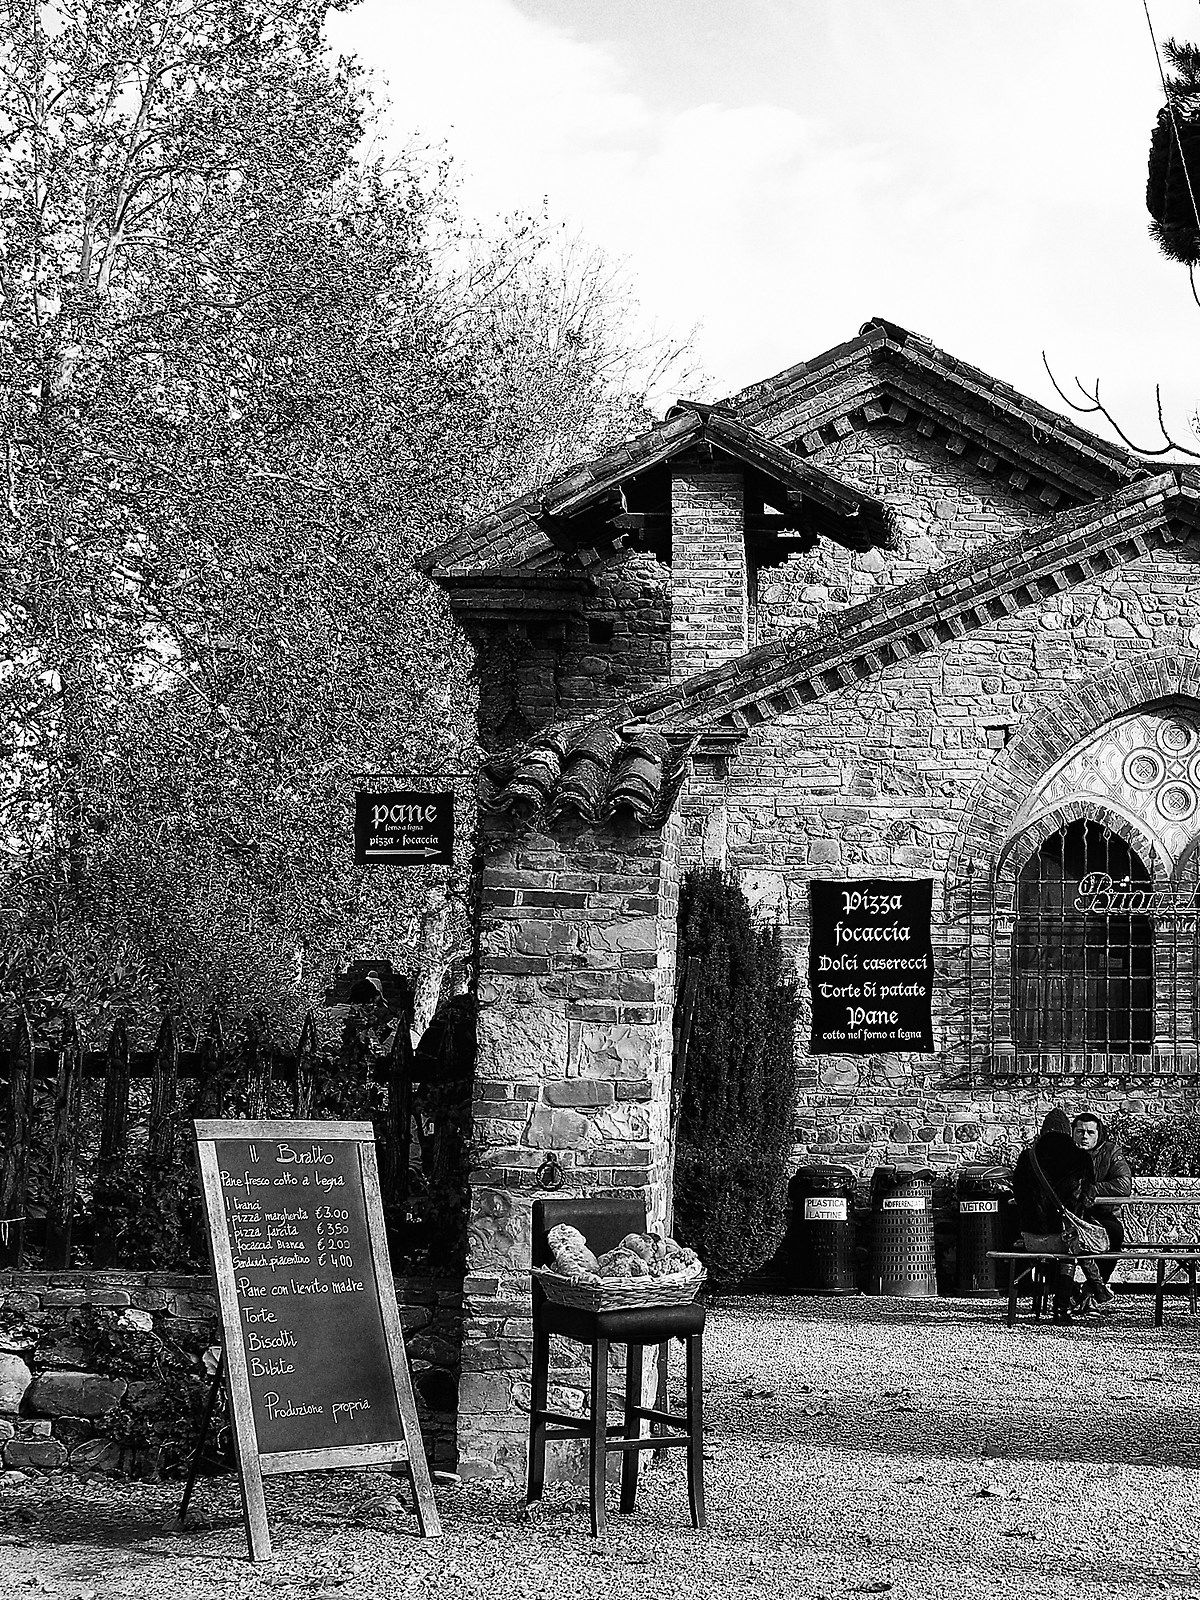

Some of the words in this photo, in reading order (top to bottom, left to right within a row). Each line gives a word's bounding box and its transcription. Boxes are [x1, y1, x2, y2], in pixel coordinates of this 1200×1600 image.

[371, 804, 438, 829] pane
[369, 834, 394, 847] pizza
[402, 833, 439, 846] focaccia
[841, 888, 903, 915] Pizza
[833, 920, 911, 946] focaccia
[818, 953, 859, 971] Dolci
[862, 953, 928, 970] caserecci
[818, 981, 861, 998] Torte
[863, 981, 877, 998] di
[879, 982, 926, 999] patate
[845, 1006, 899, 1029] Pane
[822, 1029, 846, 1040] cotto
[847, 1028, 863, 1040] nel
[863, 1028, 888, 1041] forno
[889, 1031, 896, 1039] a
[897, 1028, 922, 1041] legna
[249, 1144, 261, 1163] Il
[276, 1143, 334, 1165] Buratto
[220, 1170, 243, 1187] Pane
[244, 1170, 270, 1196] fresco
[273, 1171, 298, 1187] cotto
[302, 1177, 310, 1186] a
[315, 1170, 345, 1193] legna
[265, 1207, 309, 1227] margherita
[962, 1201, 993, 1212] VETRO
[266, 1224, 299, 1242] farcita
[238, 1276, 267, 1298] Pane
[271, 1285, 288, 1296] con
[290, 1277, 329, 1295] lievito
[331, 1277, 364, 1293] madre
[242, 1306, 278, 1324] Torte
[248, 1329, 298, 1351] Biscotti
[250, 1357, 296, 1377] Bibite
[263, 1391, 324, 1421] Produzione
[331, 1397, 371, 1424] propria
